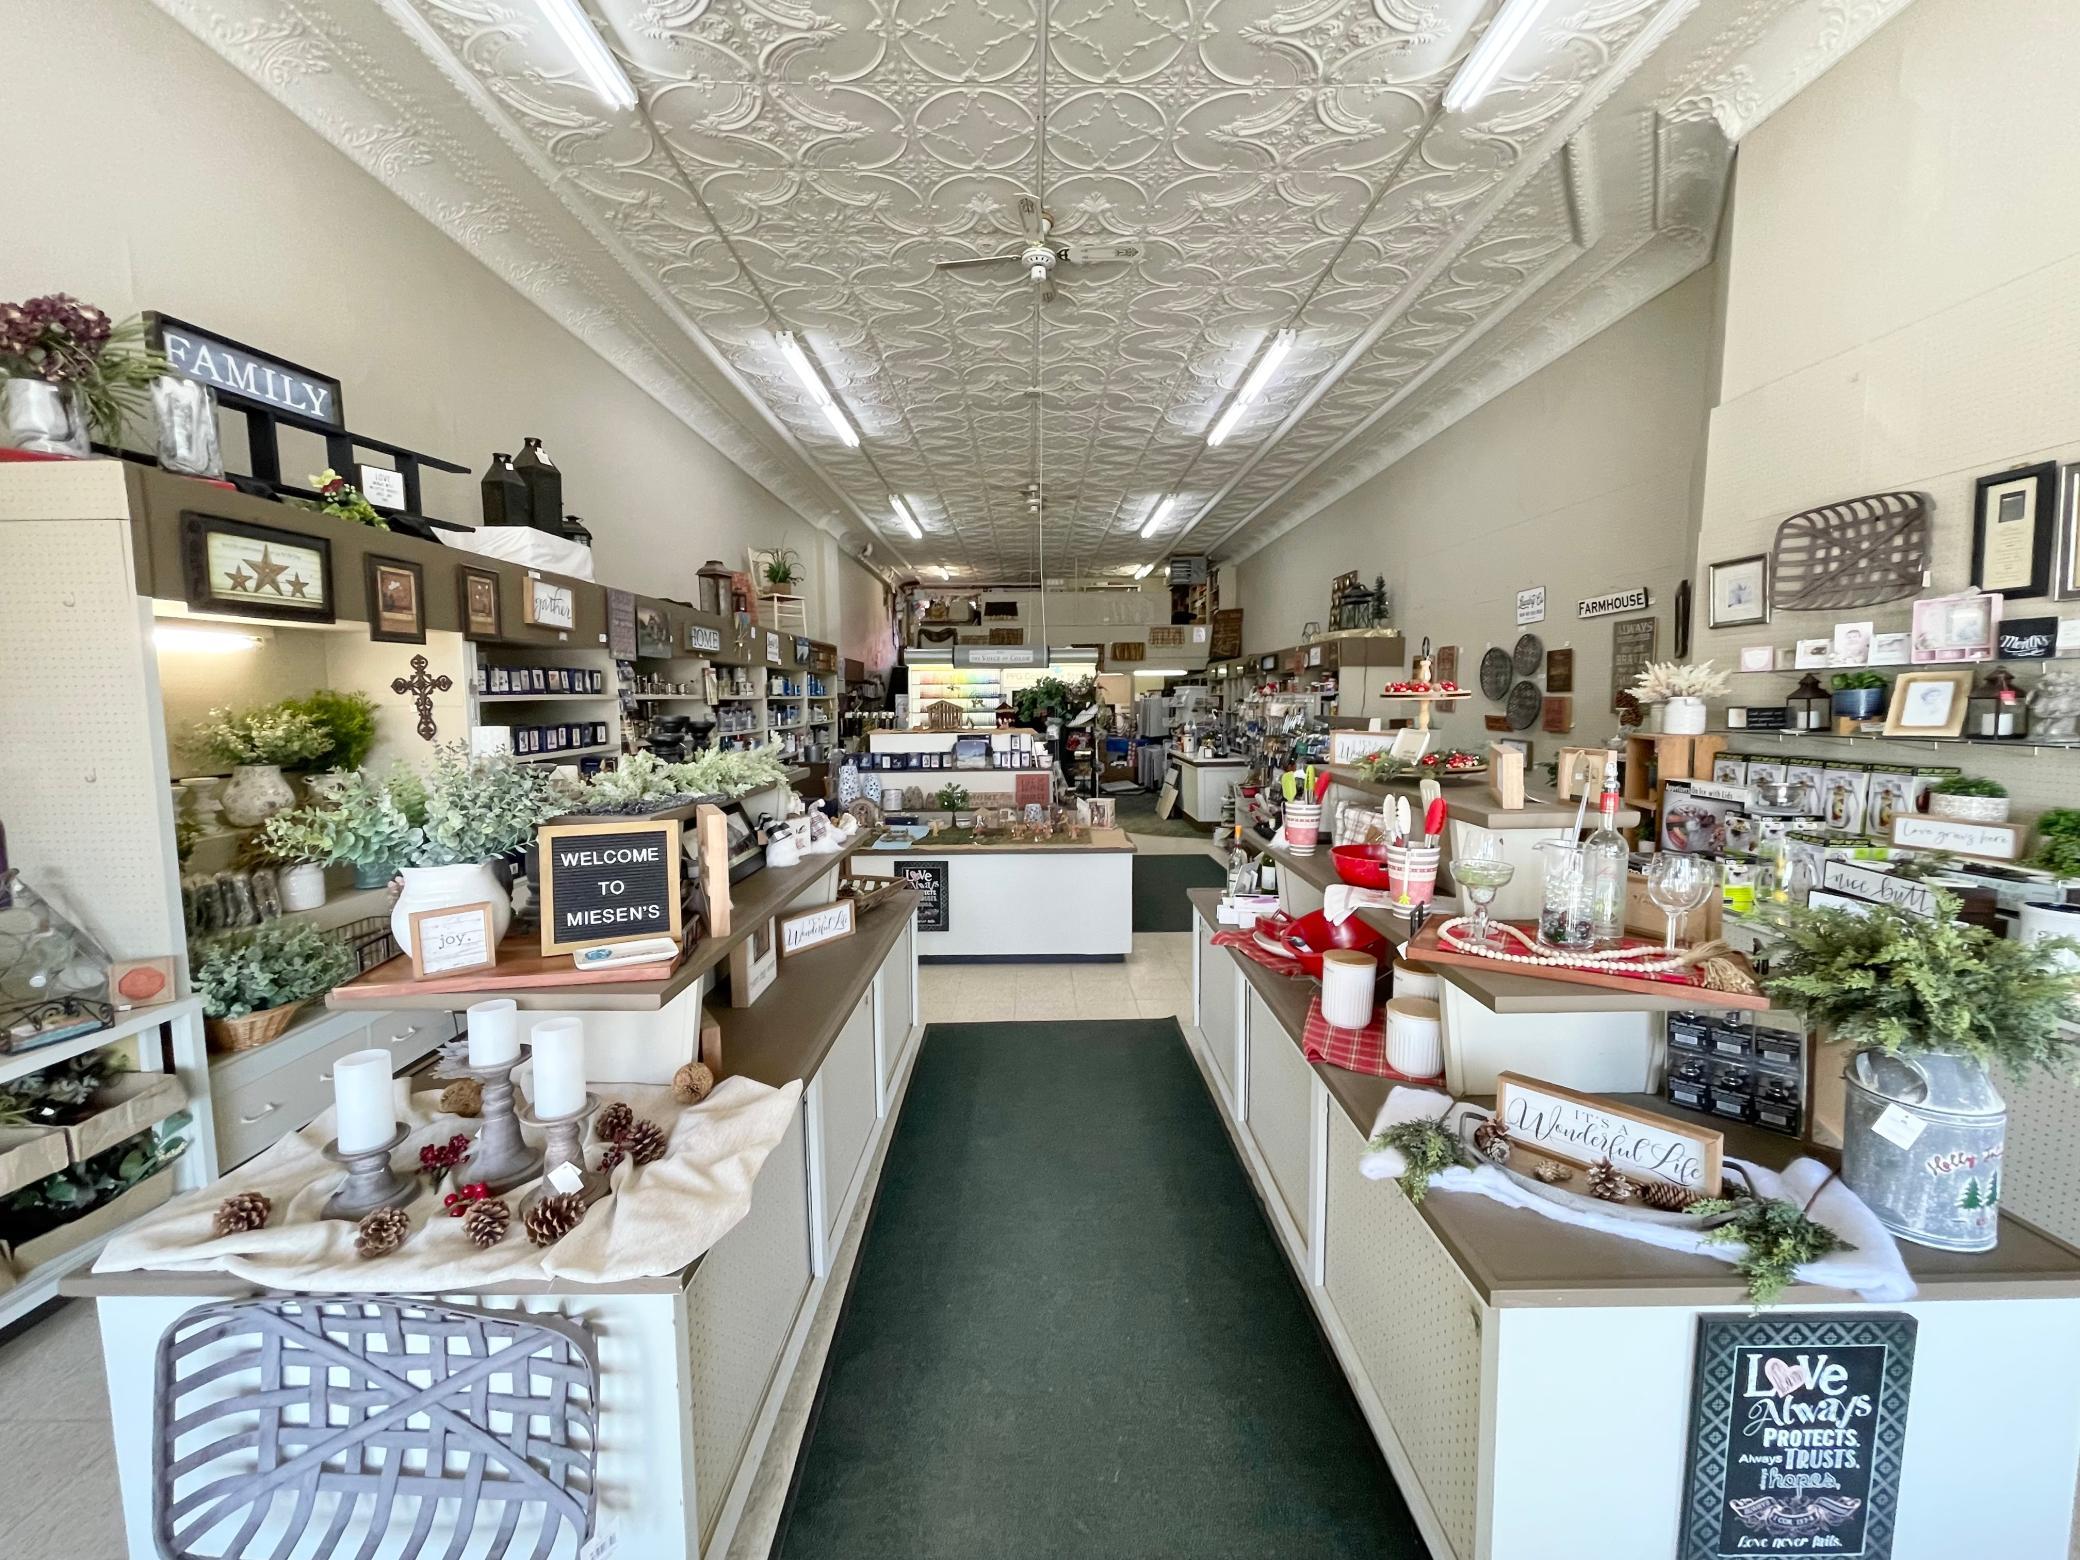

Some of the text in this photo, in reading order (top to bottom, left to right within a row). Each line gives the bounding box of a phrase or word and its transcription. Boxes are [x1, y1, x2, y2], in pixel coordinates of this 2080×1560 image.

[163, 331, 329, 417] FAMILY
[1578, 592, 1644, 617] FARMHOUSE
[560, 847, 660, 867] WELCOME
[598, 880, 625, 896] TO
[1825, 873, 1869, 895] nice
[1871, 876, 1936, 912] butt
[566, 904, 660, 927] MIESEN'S
[438, 934, 471, 950] joy.
[785, 914, 833, 946] Wonderful
[1574, 1109, 1629, 1136] IT'S A
[1506, 1096, 1650, 1162] Wonderful
[1638, 1142, 1703, 1187] Life
[1927, 1152, 1977, 1177] Holly
[1743, 1394, 1872, 1437] Always
[1763, 1427, 1861, 1448] PROTECTS.
[1739, 1448, 1860, 1469] Always TRUSTS.
[1737, 1535, 1768, 1548] Love
[1772, 1536, 1809, 1549] never
